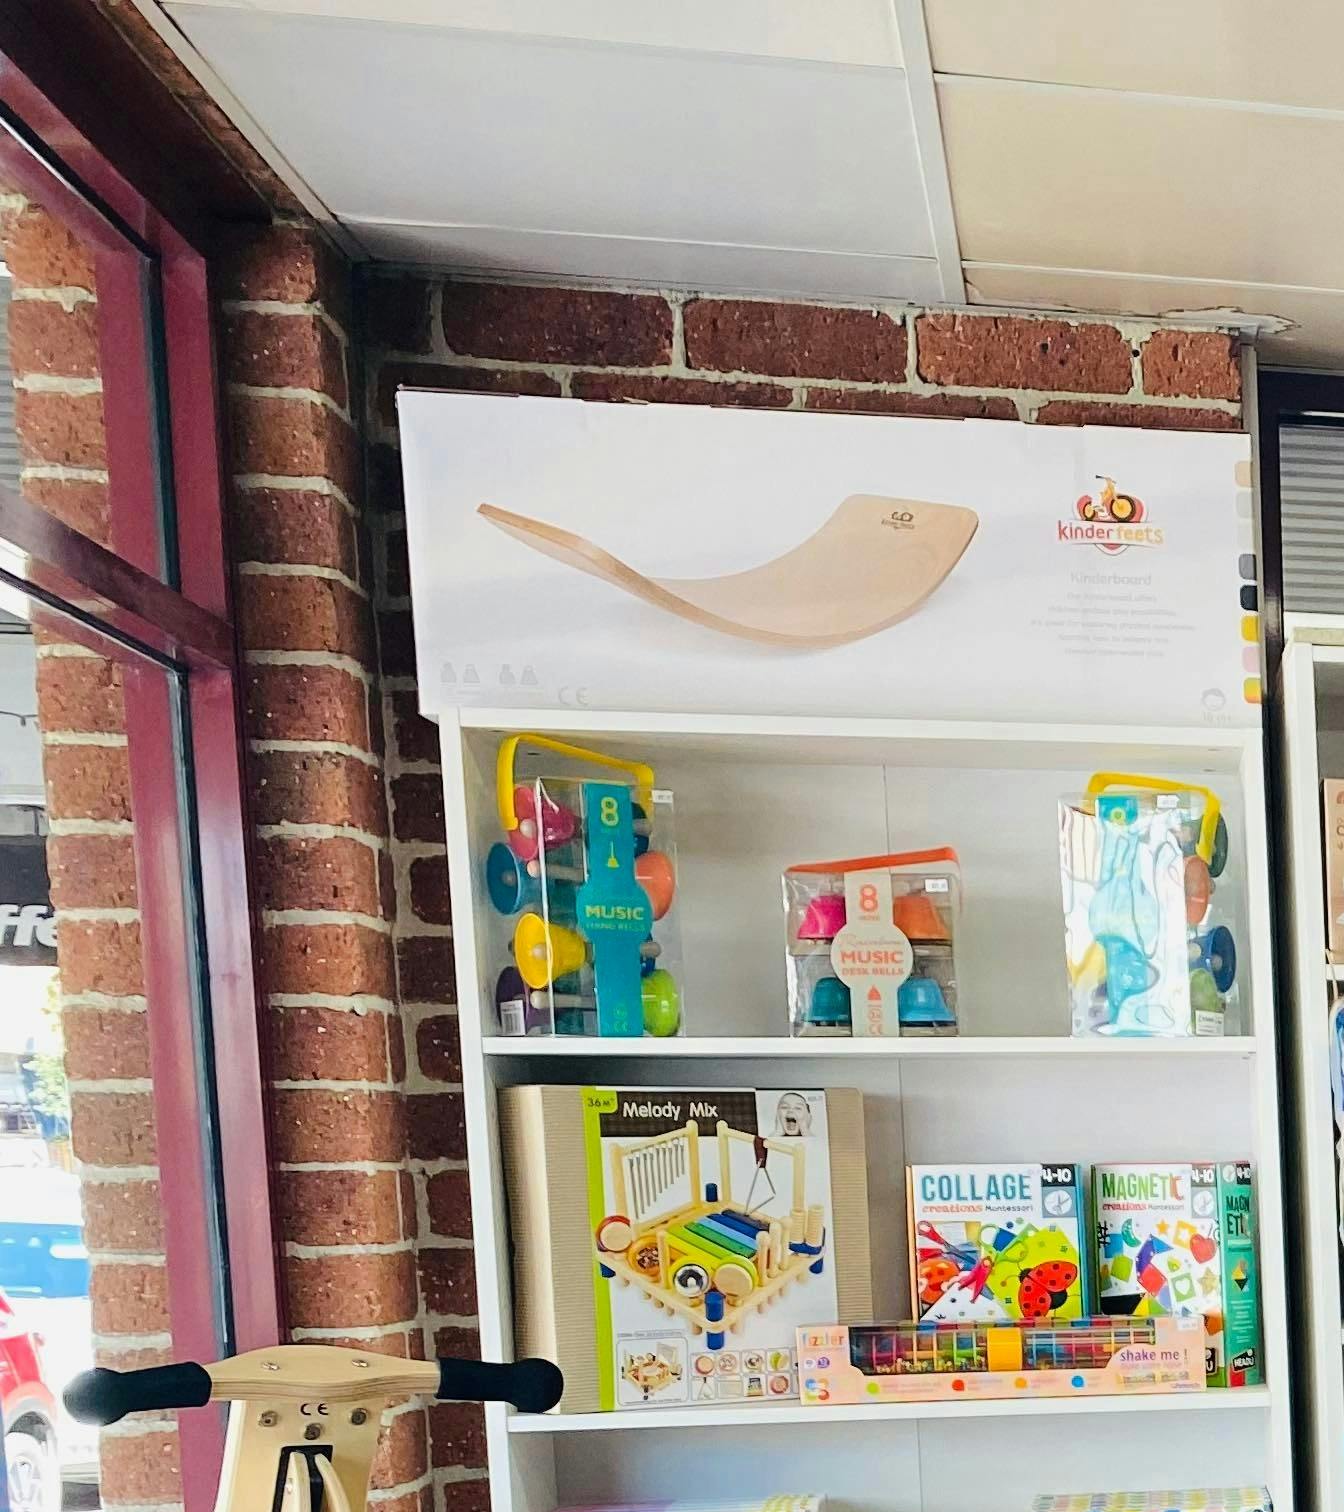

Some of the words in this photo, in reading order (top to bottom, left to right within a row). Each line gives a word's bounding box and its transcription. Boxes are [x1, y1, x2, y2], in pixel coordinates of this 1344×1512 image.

[601, 797, 619, 827] 8
[858, 883, 879, 913] 8
[585, 904, 645, 921] MUSIC
[840, 950, 904, 966] MUSIC
[871, 966, 905, 977] BELLS
[622, 1101, 682, 1121] Melody
[689, 1100, 719, 1118] Mix
[1041, 1167, 1072, 1184] 4-10
[921, 1173, 1033, 1202] COLLAGE
[1101, 1172, 1186, 1202] MAGNETIC
[921, 1202, 984, 1213] creations
[985, 1203, 1034, 1213] Montessori
[1102, 1202, 1147, 1211] creations
[1119, 1348, 1157, 1363] shake
[1160, 1351, 1180, 1362] me
[299, 1402, 329, 1416] CE
